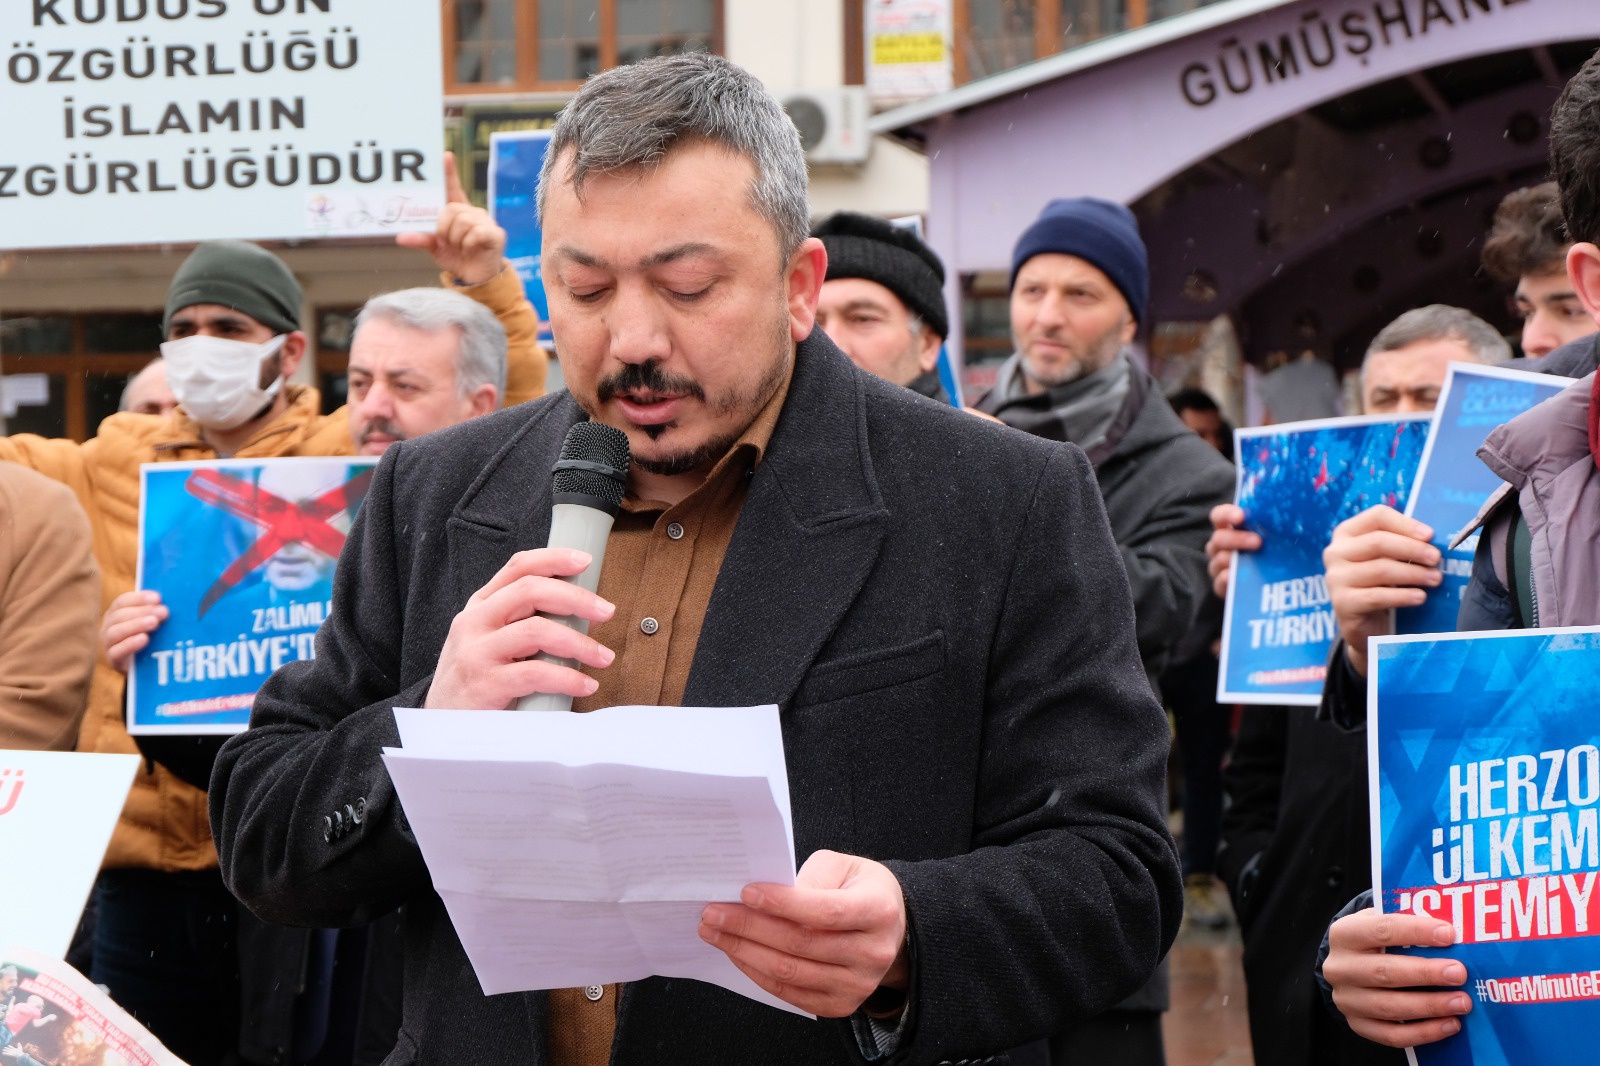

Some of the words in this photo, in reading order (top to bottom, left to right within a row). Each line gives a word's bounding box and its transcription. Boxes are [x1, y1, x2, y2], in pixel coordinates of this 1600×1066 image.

[8, 26, 359, 84] ÖZGÜRLÜĞÜ
[1180, 0, 1530, 107] GÜMÜŞHA
[63, 96, 306, 139] İSLAMIN
[1450, 744, 1600, 822] HERZO
[1432, 807, 1599, 885] ÜLKEM
